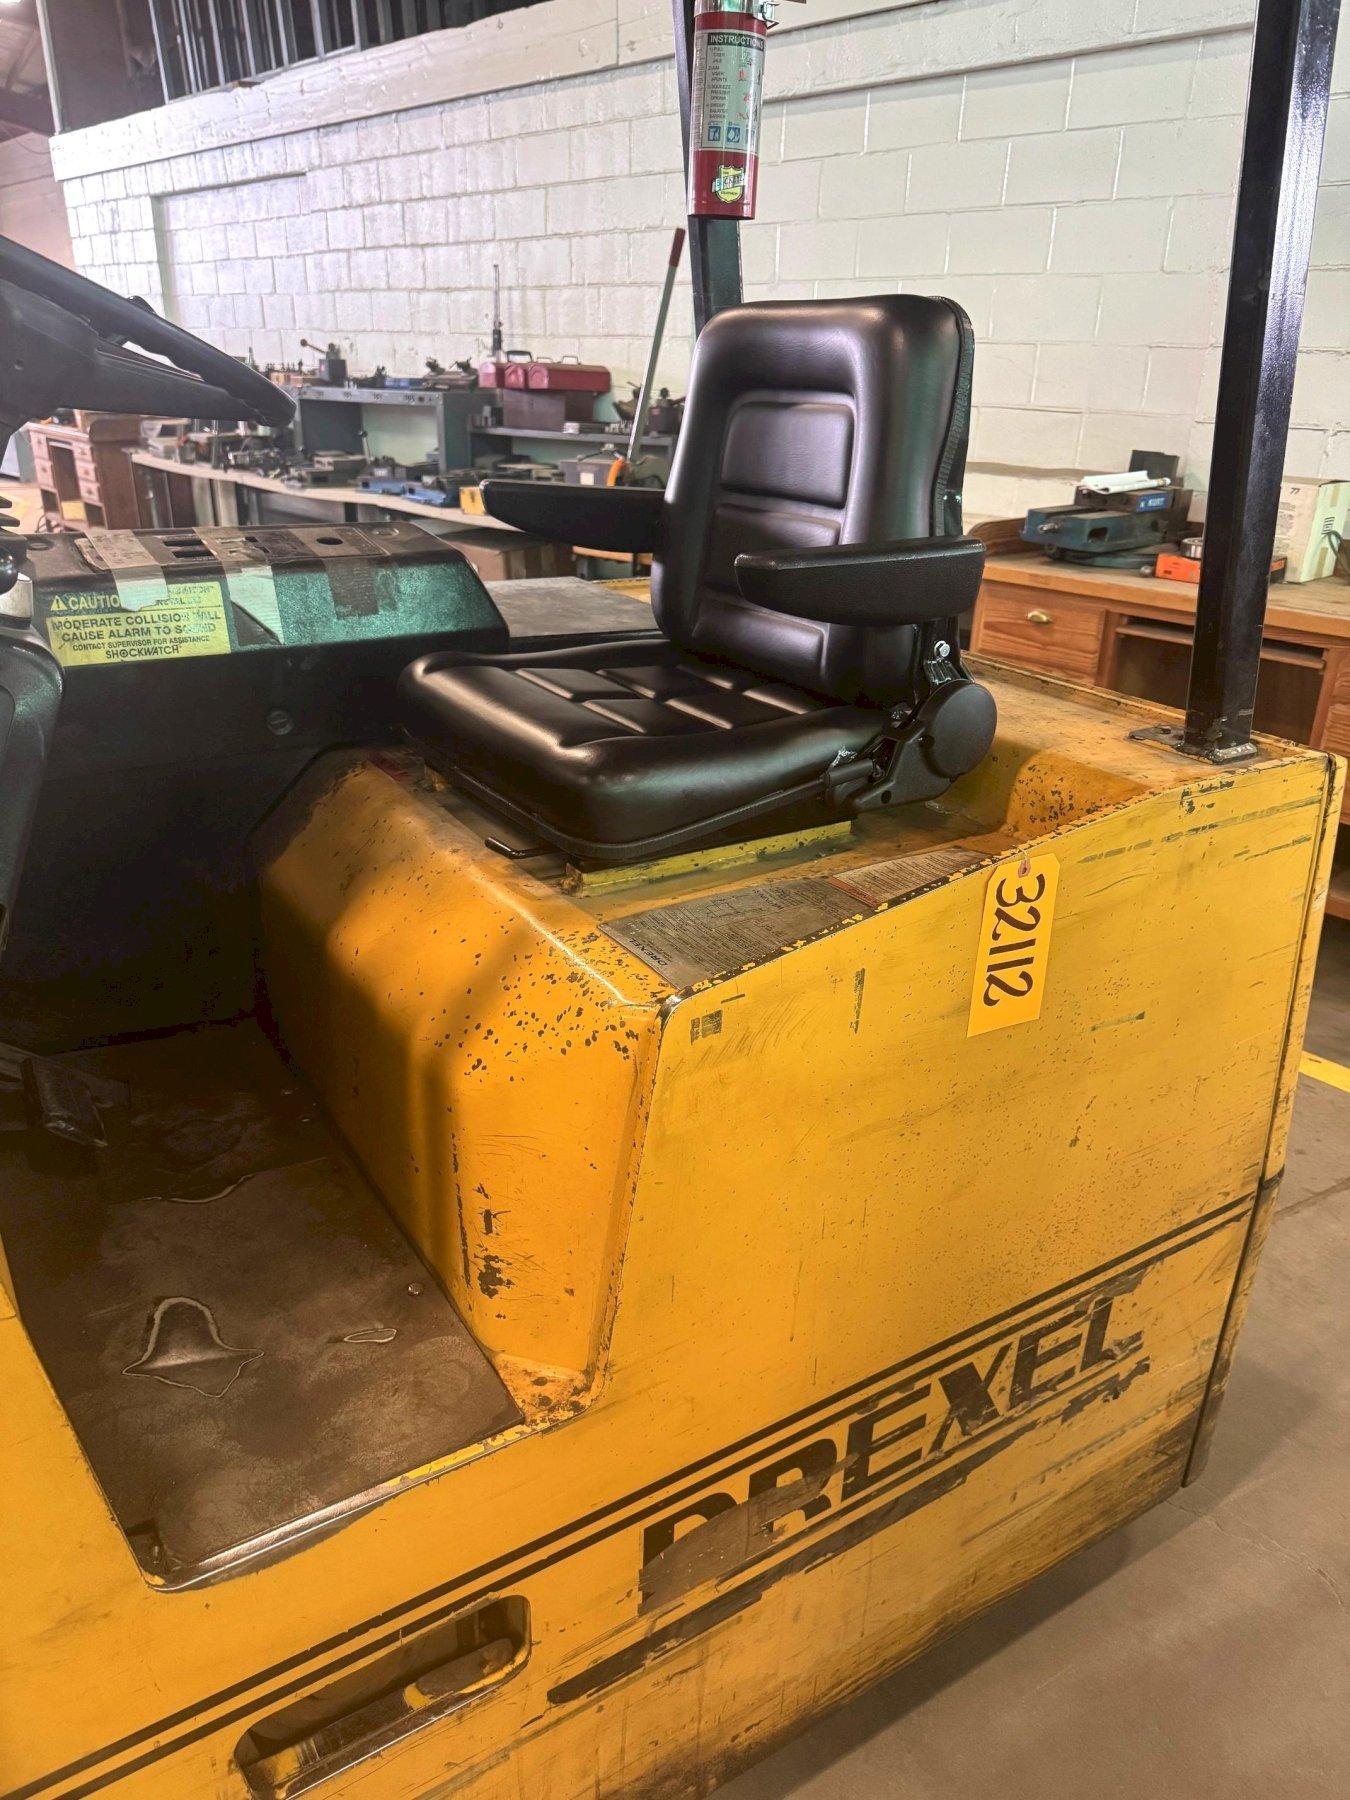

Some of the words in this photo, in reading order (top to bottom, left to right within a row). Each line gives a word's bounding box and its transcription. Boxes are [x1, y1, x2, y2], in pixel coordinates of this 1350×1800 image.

[710, 34, 763, 49] INSTRUCTIONS
[69, 595, 121, 610] CAUTIO
[52, 616, 122, 630] MODERATE
[62, 630, 105, 642] CAUSE
[109, 626, 151, 638] ALARM
[155, 626, 171, 636] TO
[72, 641, 106, 650] CONTACT
[108, 639, 152, 648] SUPERVISOR
[169, 635, 210, 644] ASSISTANCE
[982, 873, 1046, 1008] 32112
[630, 938, 669, 967] DREXEL
